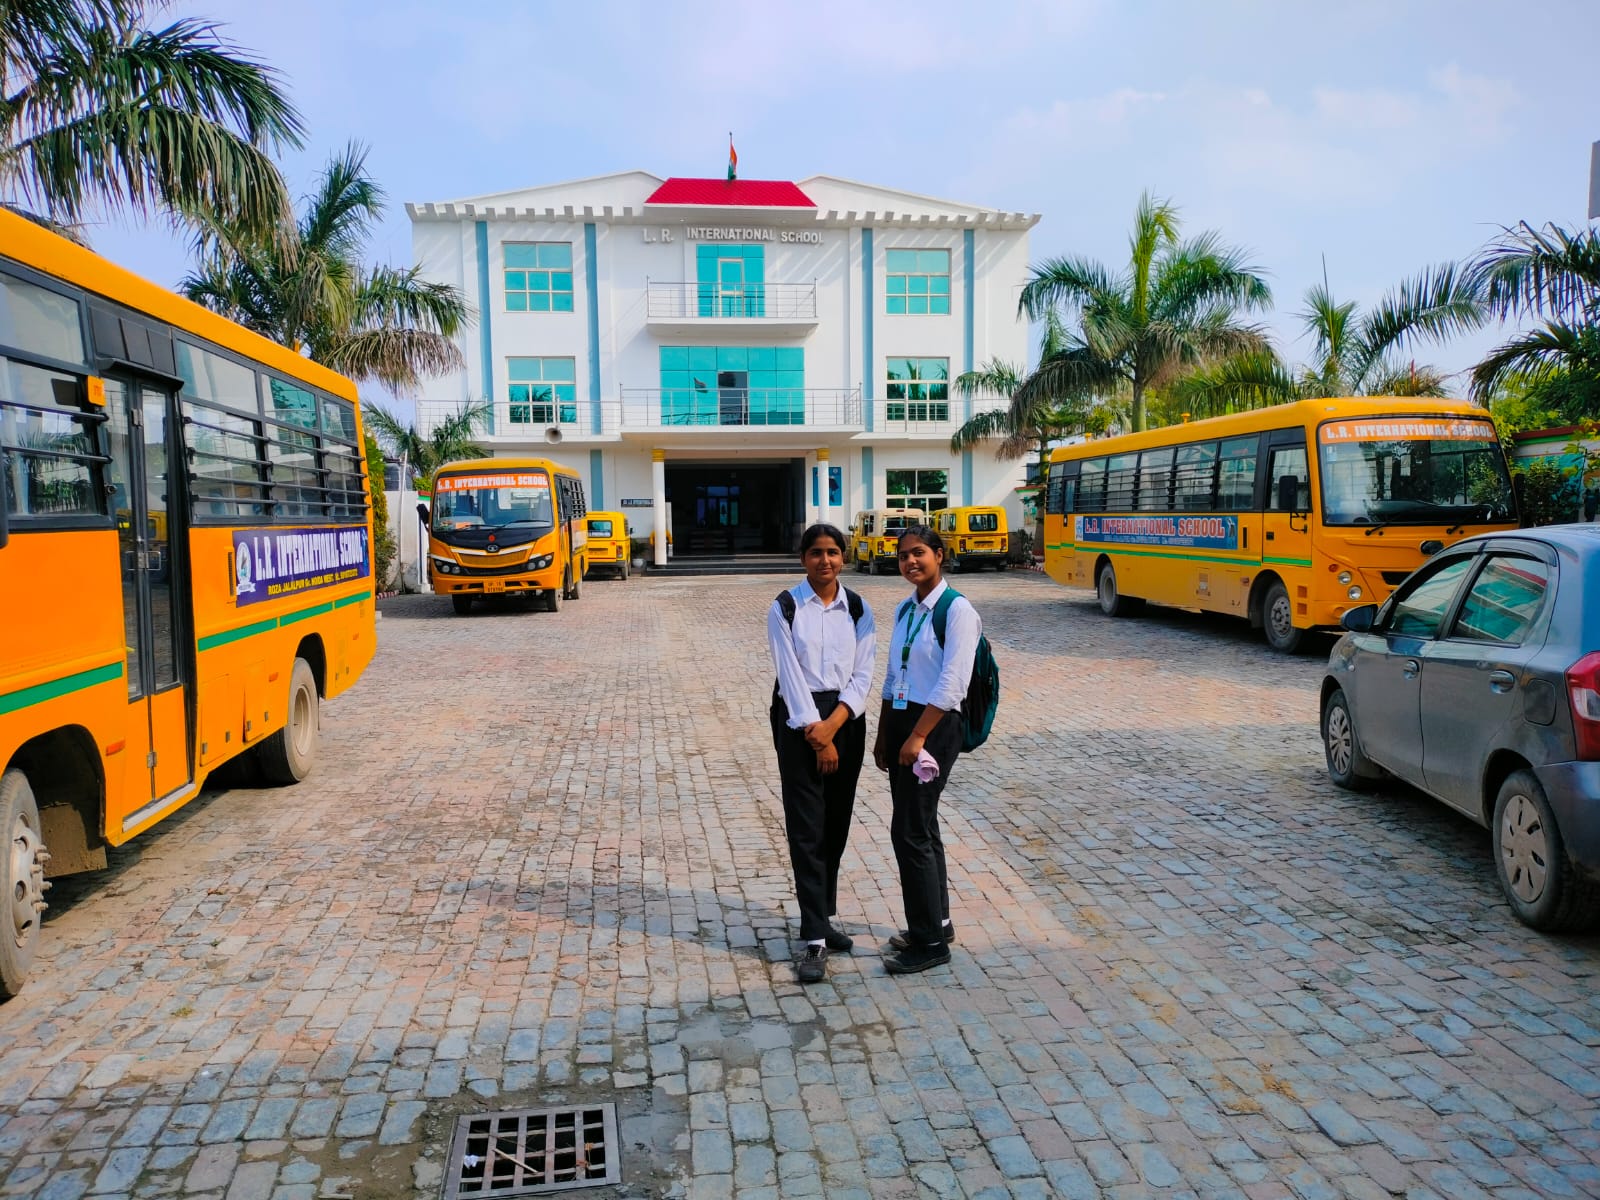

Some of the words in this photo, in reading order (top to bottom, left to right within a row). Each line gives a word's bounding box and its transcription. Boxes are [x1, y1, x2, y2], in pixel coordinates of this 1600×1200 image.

[687, 227, 775, 240] INTERNATIONAL
[781, 231, 824, 243] SCHOOL
[1354, 424, 1449, 437] INTERNATIONAL
[1452, 424, 1492, 438] SCHOOL
[454, 476, 515, 488] INTERNATIONAL
[518, 475, 549, 486] SCHOOL
[1101, 518, 1176, 536] INTERNATIONAL
[1178, 518, 1226, 539] SCHOOL
[276, 533, 340, 577] INTERNATIONAL
[340, 531, 363, 566] SCHOOL
